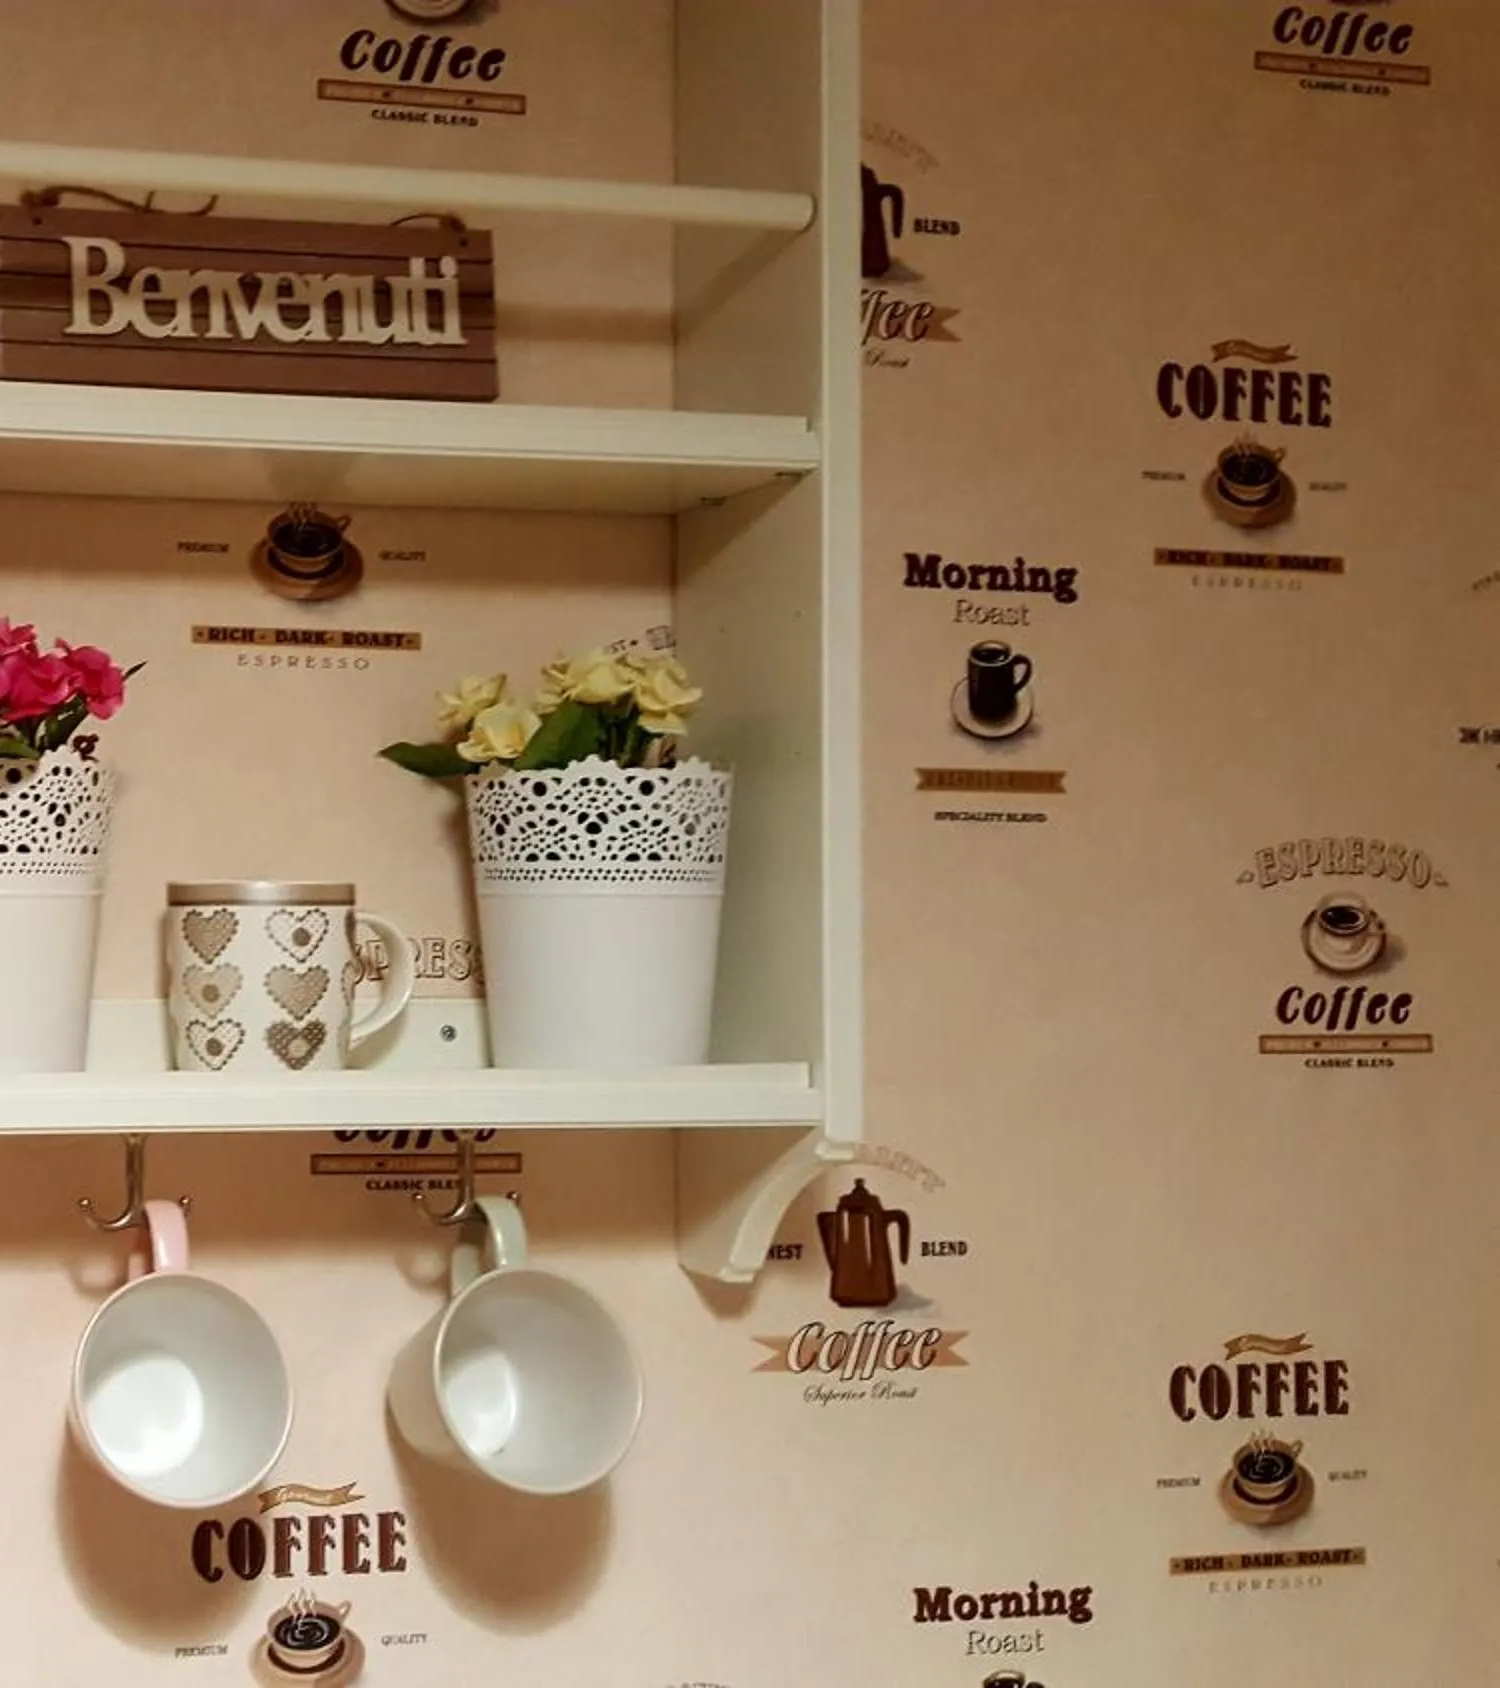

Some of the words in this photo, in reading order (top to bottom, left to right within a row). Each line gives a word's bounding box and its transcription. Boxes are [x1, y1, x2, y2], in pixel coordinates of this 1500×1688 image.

[1273, 6, 1414, 55] Coffee
[340, 29, 506, 83] Coffee
[371, 108, 428, 124] CLASSIC
[913, 217, 961, 236] BLEND
[62, 235, 468, 346] Benvenuti
[1156, 361, 1333, 428] COFFEE
[903, 553, 1080, 604] Morning
[952, 599, 1032, 627] Roast
[208, 627, 255, 643] RICH
[275, 629, 327, 645] DARK
[341, 632, 405, 648] ROAST
[237, 653, 371, 671] ESPRESSO
[1256, 837, 1434, 889] ESPRESSO
[1275, 985, 1414, 1032] Coffee
[365, 1178, 423, 1192] CLASSIC
[766, 1243, 803, 1261] NEST
[920, 1240, 968, 1258] BLEND
[787, 1319, 943, 1382] Coffee
[1168, 1359, 1350, 1423] COFFEE
[190, 1510, 408, 1584] COFFEE
[912, 1579, 1094, 1625] Morning
[964, 1628, 1046, 1657] Roast
